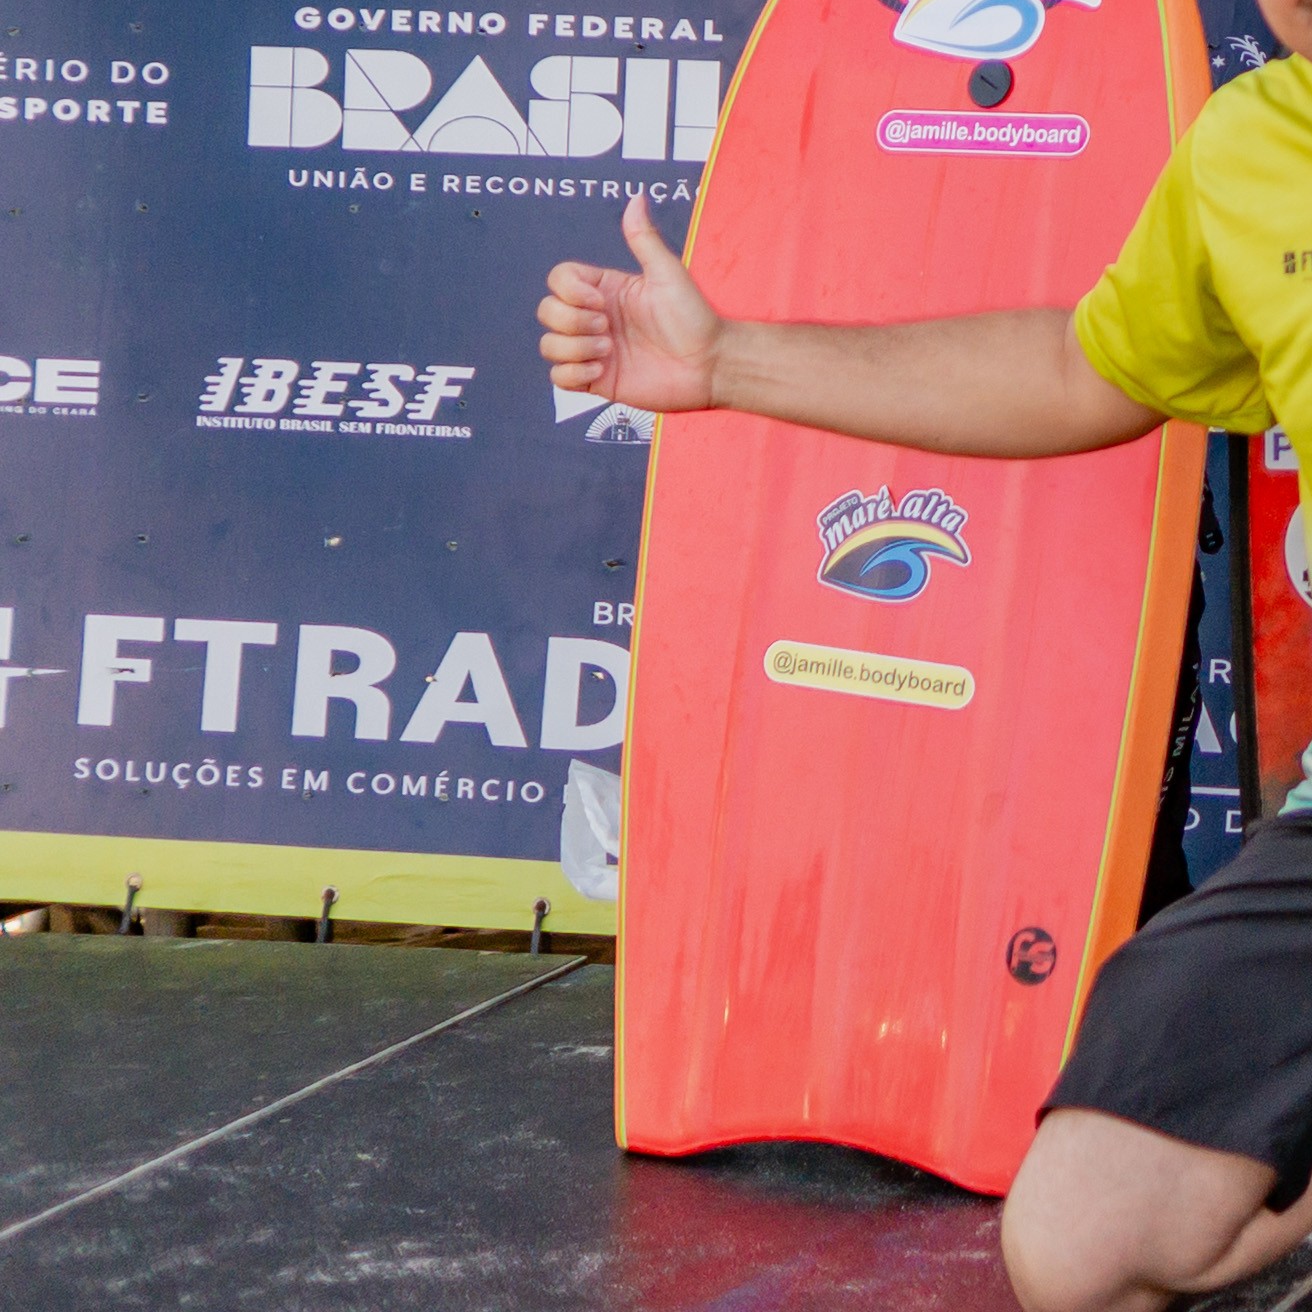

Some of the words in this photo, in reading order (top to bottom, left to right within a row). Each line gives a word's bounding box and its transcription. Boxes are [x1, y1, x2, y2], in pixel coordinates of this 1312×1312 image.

[293, 6, 507, 34] GOVERNO
[529, 14, 724, 42] FEDERAL
[111, 61, 170, 86] DO
[0, 99, 169, 125] SPORTE
[885, 119, 1081, 148] @jamille.bodyboard
[288, 168, 395, 192] UNIÃO
[410, 172, 427, 192] E
[199, 357, 476, 421] IBESF
[195, 416, 276, 431] INSTITUTO
[279, 418, 335, 434] BRASIL
[339, 421, 372, 435] SEM
[375, 422, 472, 439] FRONTEIRAS
[903, 494, 966, 532] alta
[76, 613, 632, 751] FTRAD
[773, 650, 967, 698] @jamille.bodyboard
[74, 756, 264, 790] SOLUÇÕES
[281, 768, 329, 792] EM
[346, 768, 545, 804] COMÉRCIO
